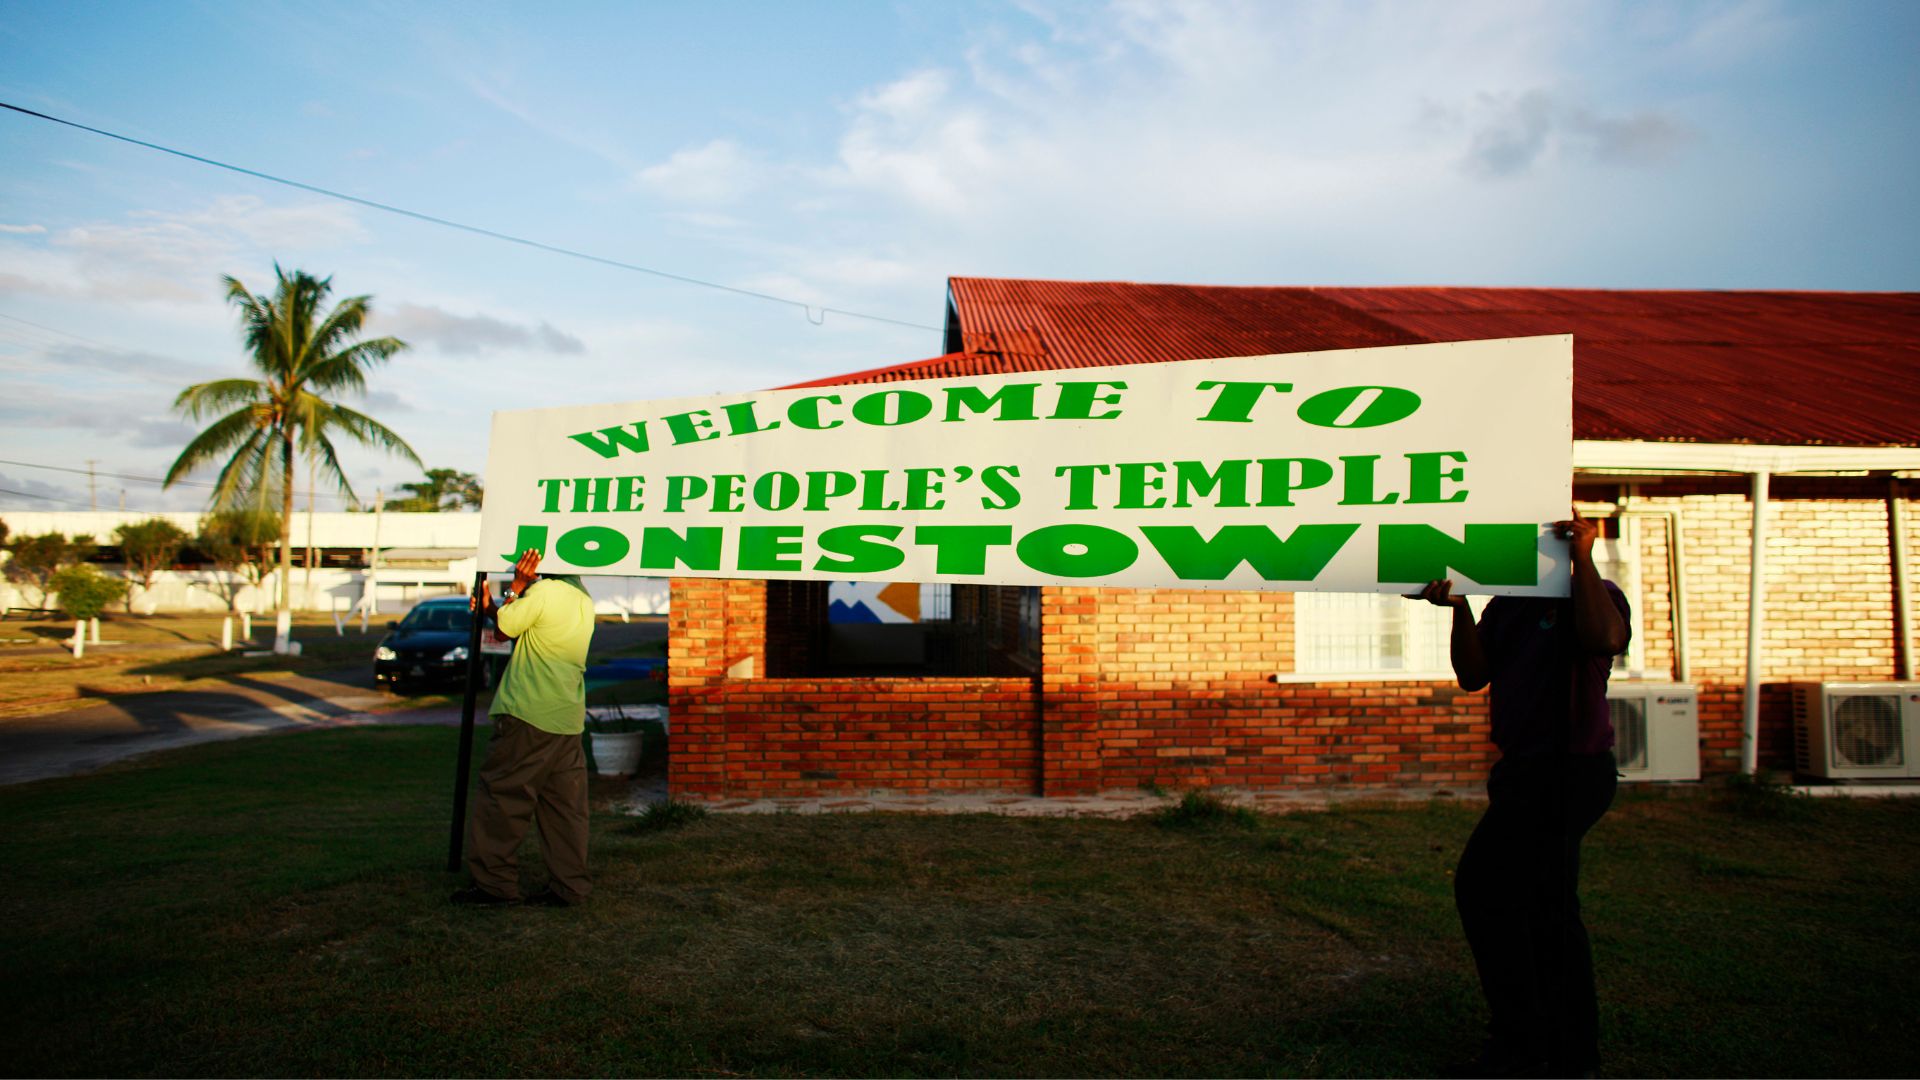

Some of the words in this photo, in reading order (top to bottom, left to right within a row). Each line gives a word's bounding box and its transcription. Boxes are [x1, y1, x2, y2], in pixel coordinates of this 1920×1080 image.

[568, 380, 1129, 459] WELCOME
[1195, 380, 1422, 429] TO
[537, 475, 646, 513] THE
[663, 465, 1021, 513] PEOPLE'S
[1055, 450, 1470, 511] TEMPLE
[500, 523, 1540, 587] JONESTOWN
